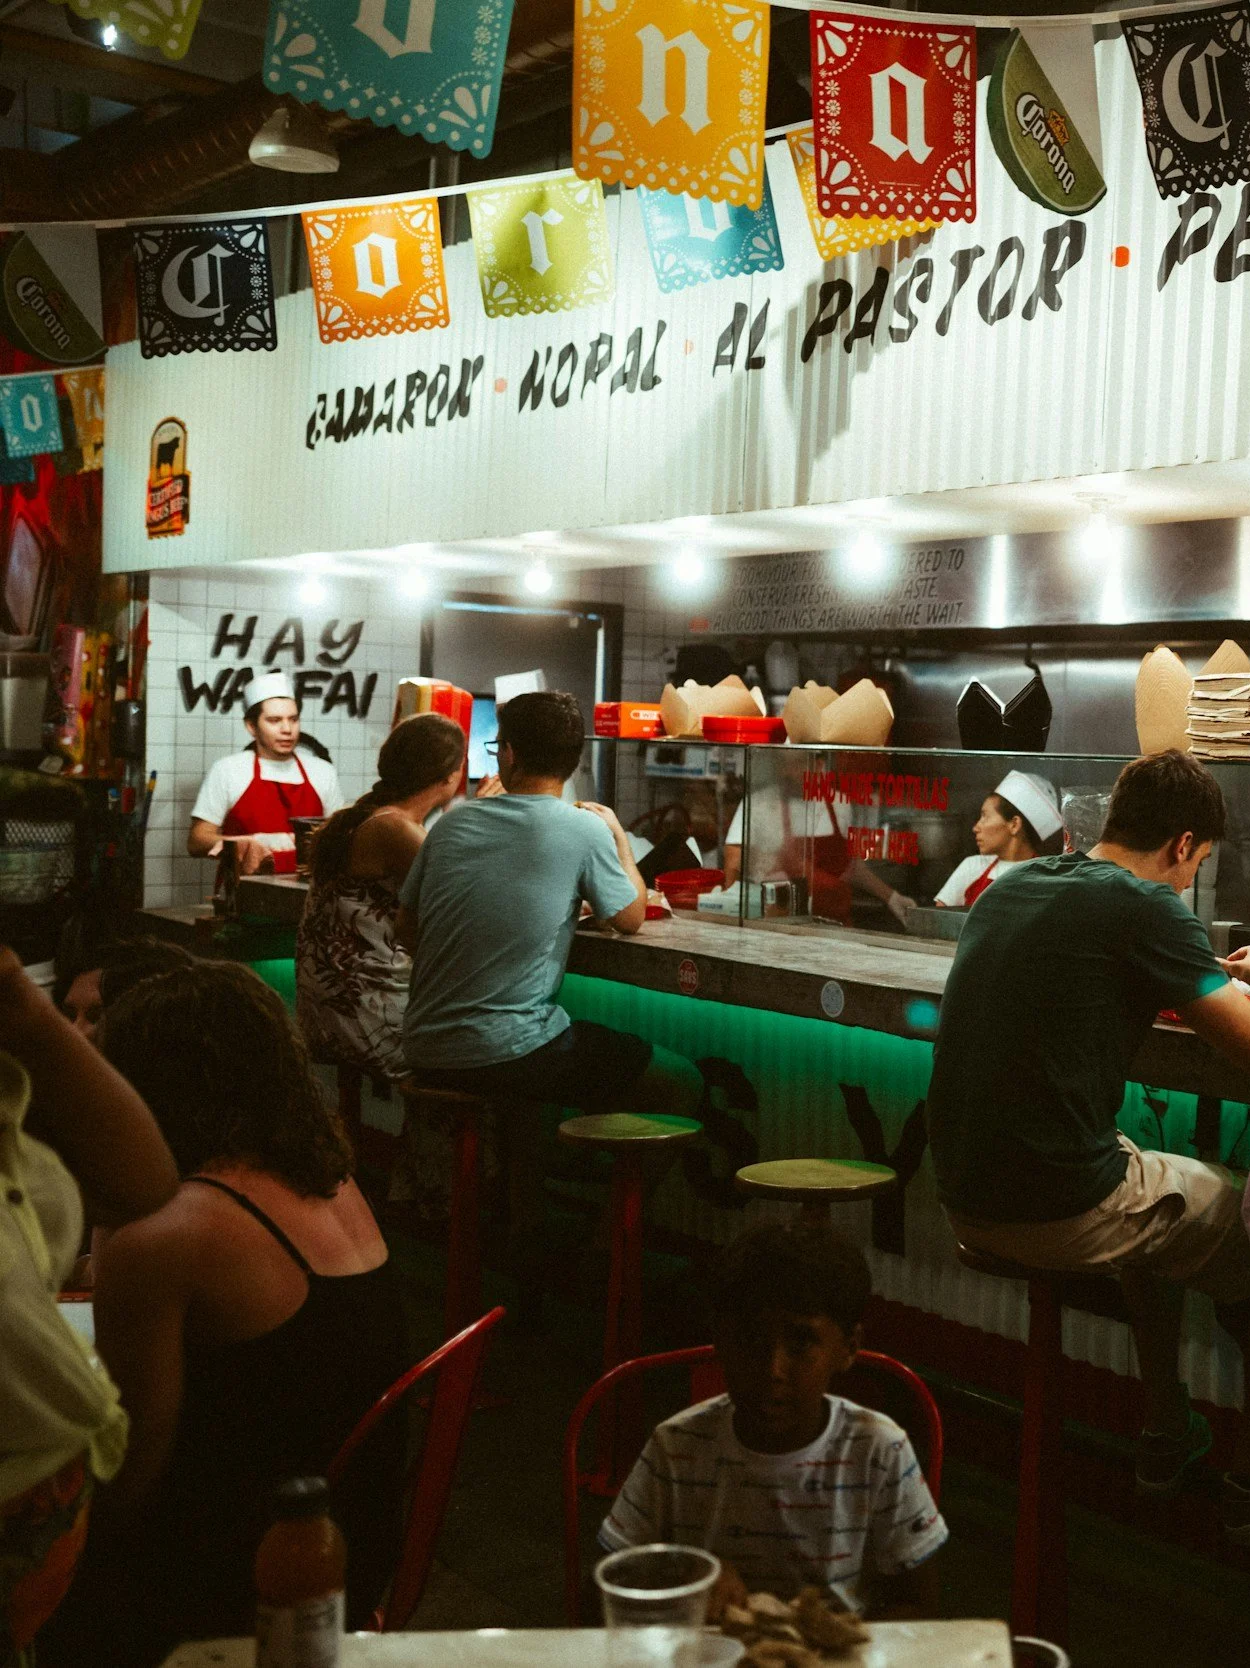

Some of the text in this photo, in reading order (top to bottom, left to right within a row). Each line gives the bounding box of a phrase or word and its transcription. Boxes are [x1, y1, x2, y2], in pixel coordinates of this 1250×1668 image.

[1016, 93, 1075, 195] Corona
[16, 275, 71, 350] Corona
[518, 319, 667, 415] NOPAL
[712, 298, 771, 378] AL
[801, 219, 1087, 364] PASTOR
[211, 612, 365, 668] HAY
[803, 770, 950, 812] HAND MADE TORTILLAS
